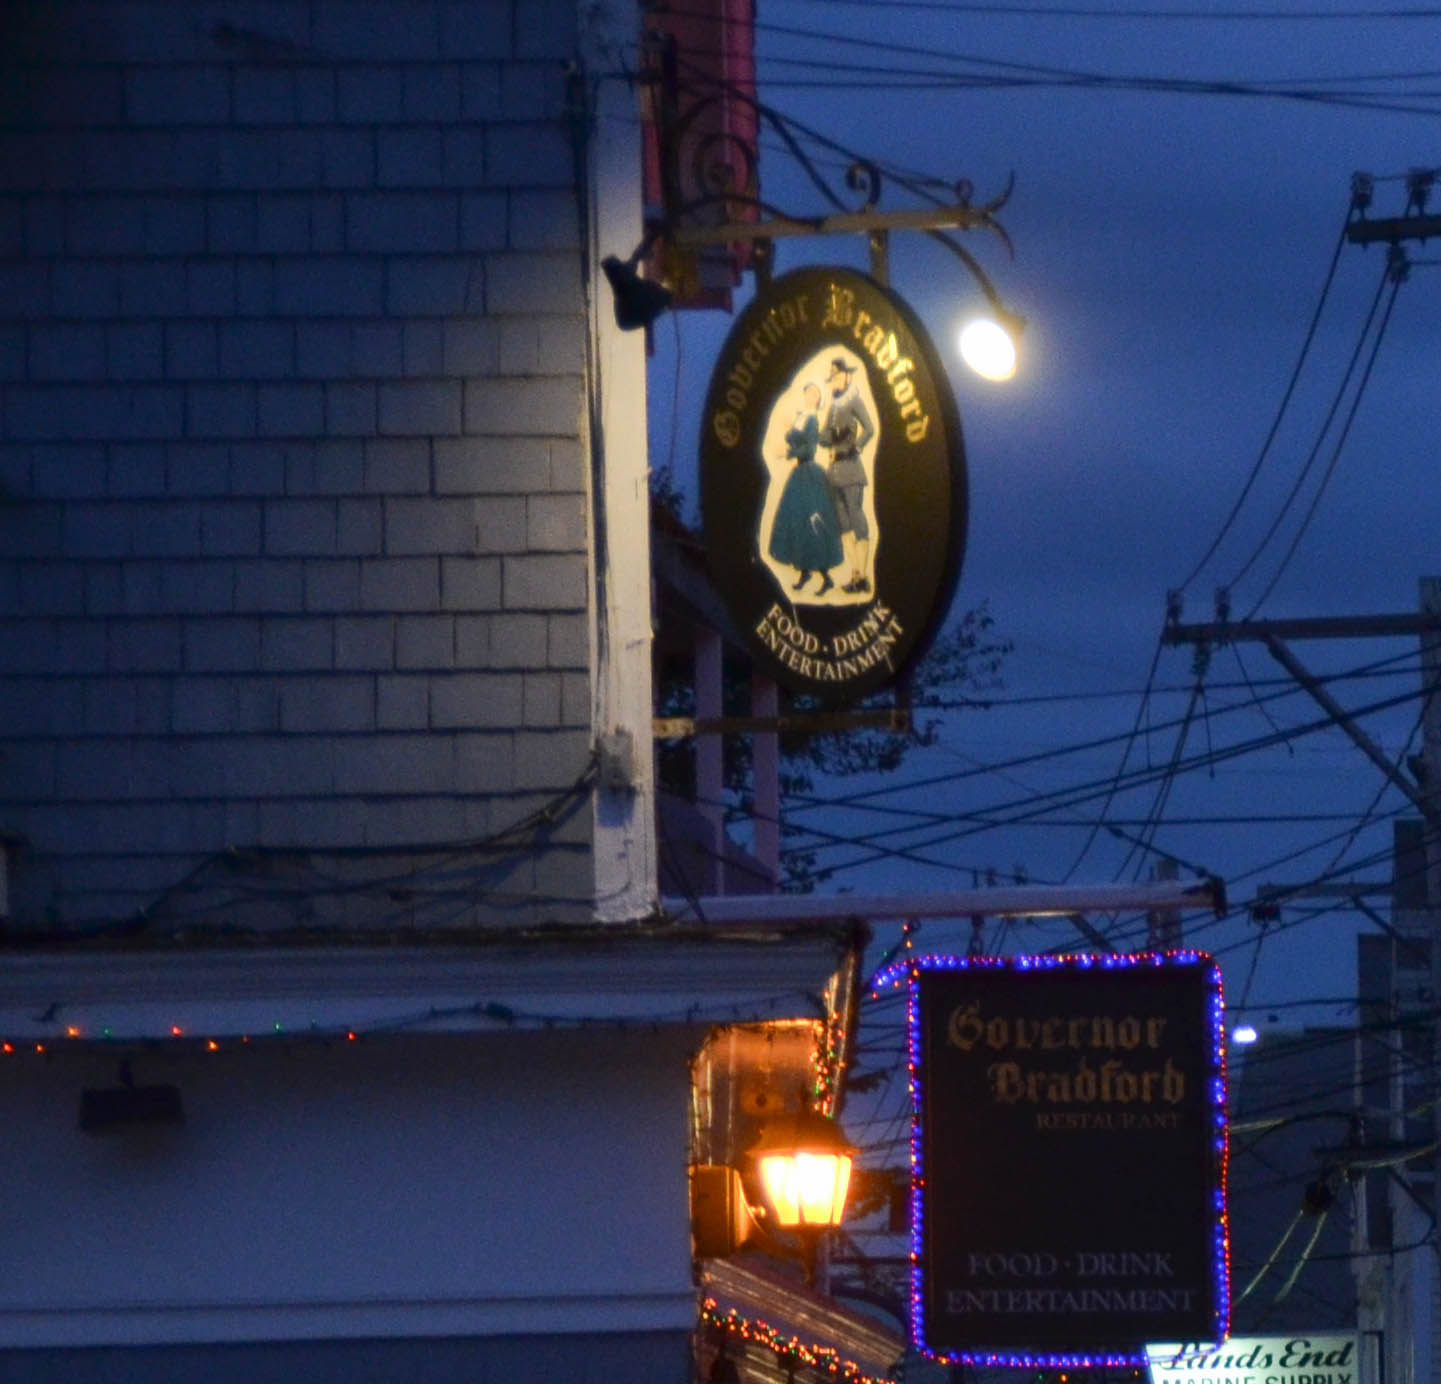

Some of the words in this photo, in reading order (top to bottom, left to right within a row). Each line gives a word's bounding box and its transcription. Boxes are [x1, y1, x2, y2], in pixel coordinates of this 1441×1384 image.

[715, 294, 810, 448] Governor
[824, 283, 928, 446] Bradford
[756, 617, 905, 682] ENTERTAINMENT
[767, 603, 821, 656] FOOD
[832, 599, 893, 656] DRINK
[946, 1002, 1168, 1053] Governor
[988, 1058, 1186, 1105] Bradford
[1036, 1111, 1180, 1129] RESTAURANT
[968, 1252, 1058, 1277] FOOD
[1076, 1252, 1174, 1277] DRINK
[946, 1289, 1196, 1314] ENTERTAINMENT
[1279, 1339, 1354, 1369] End
